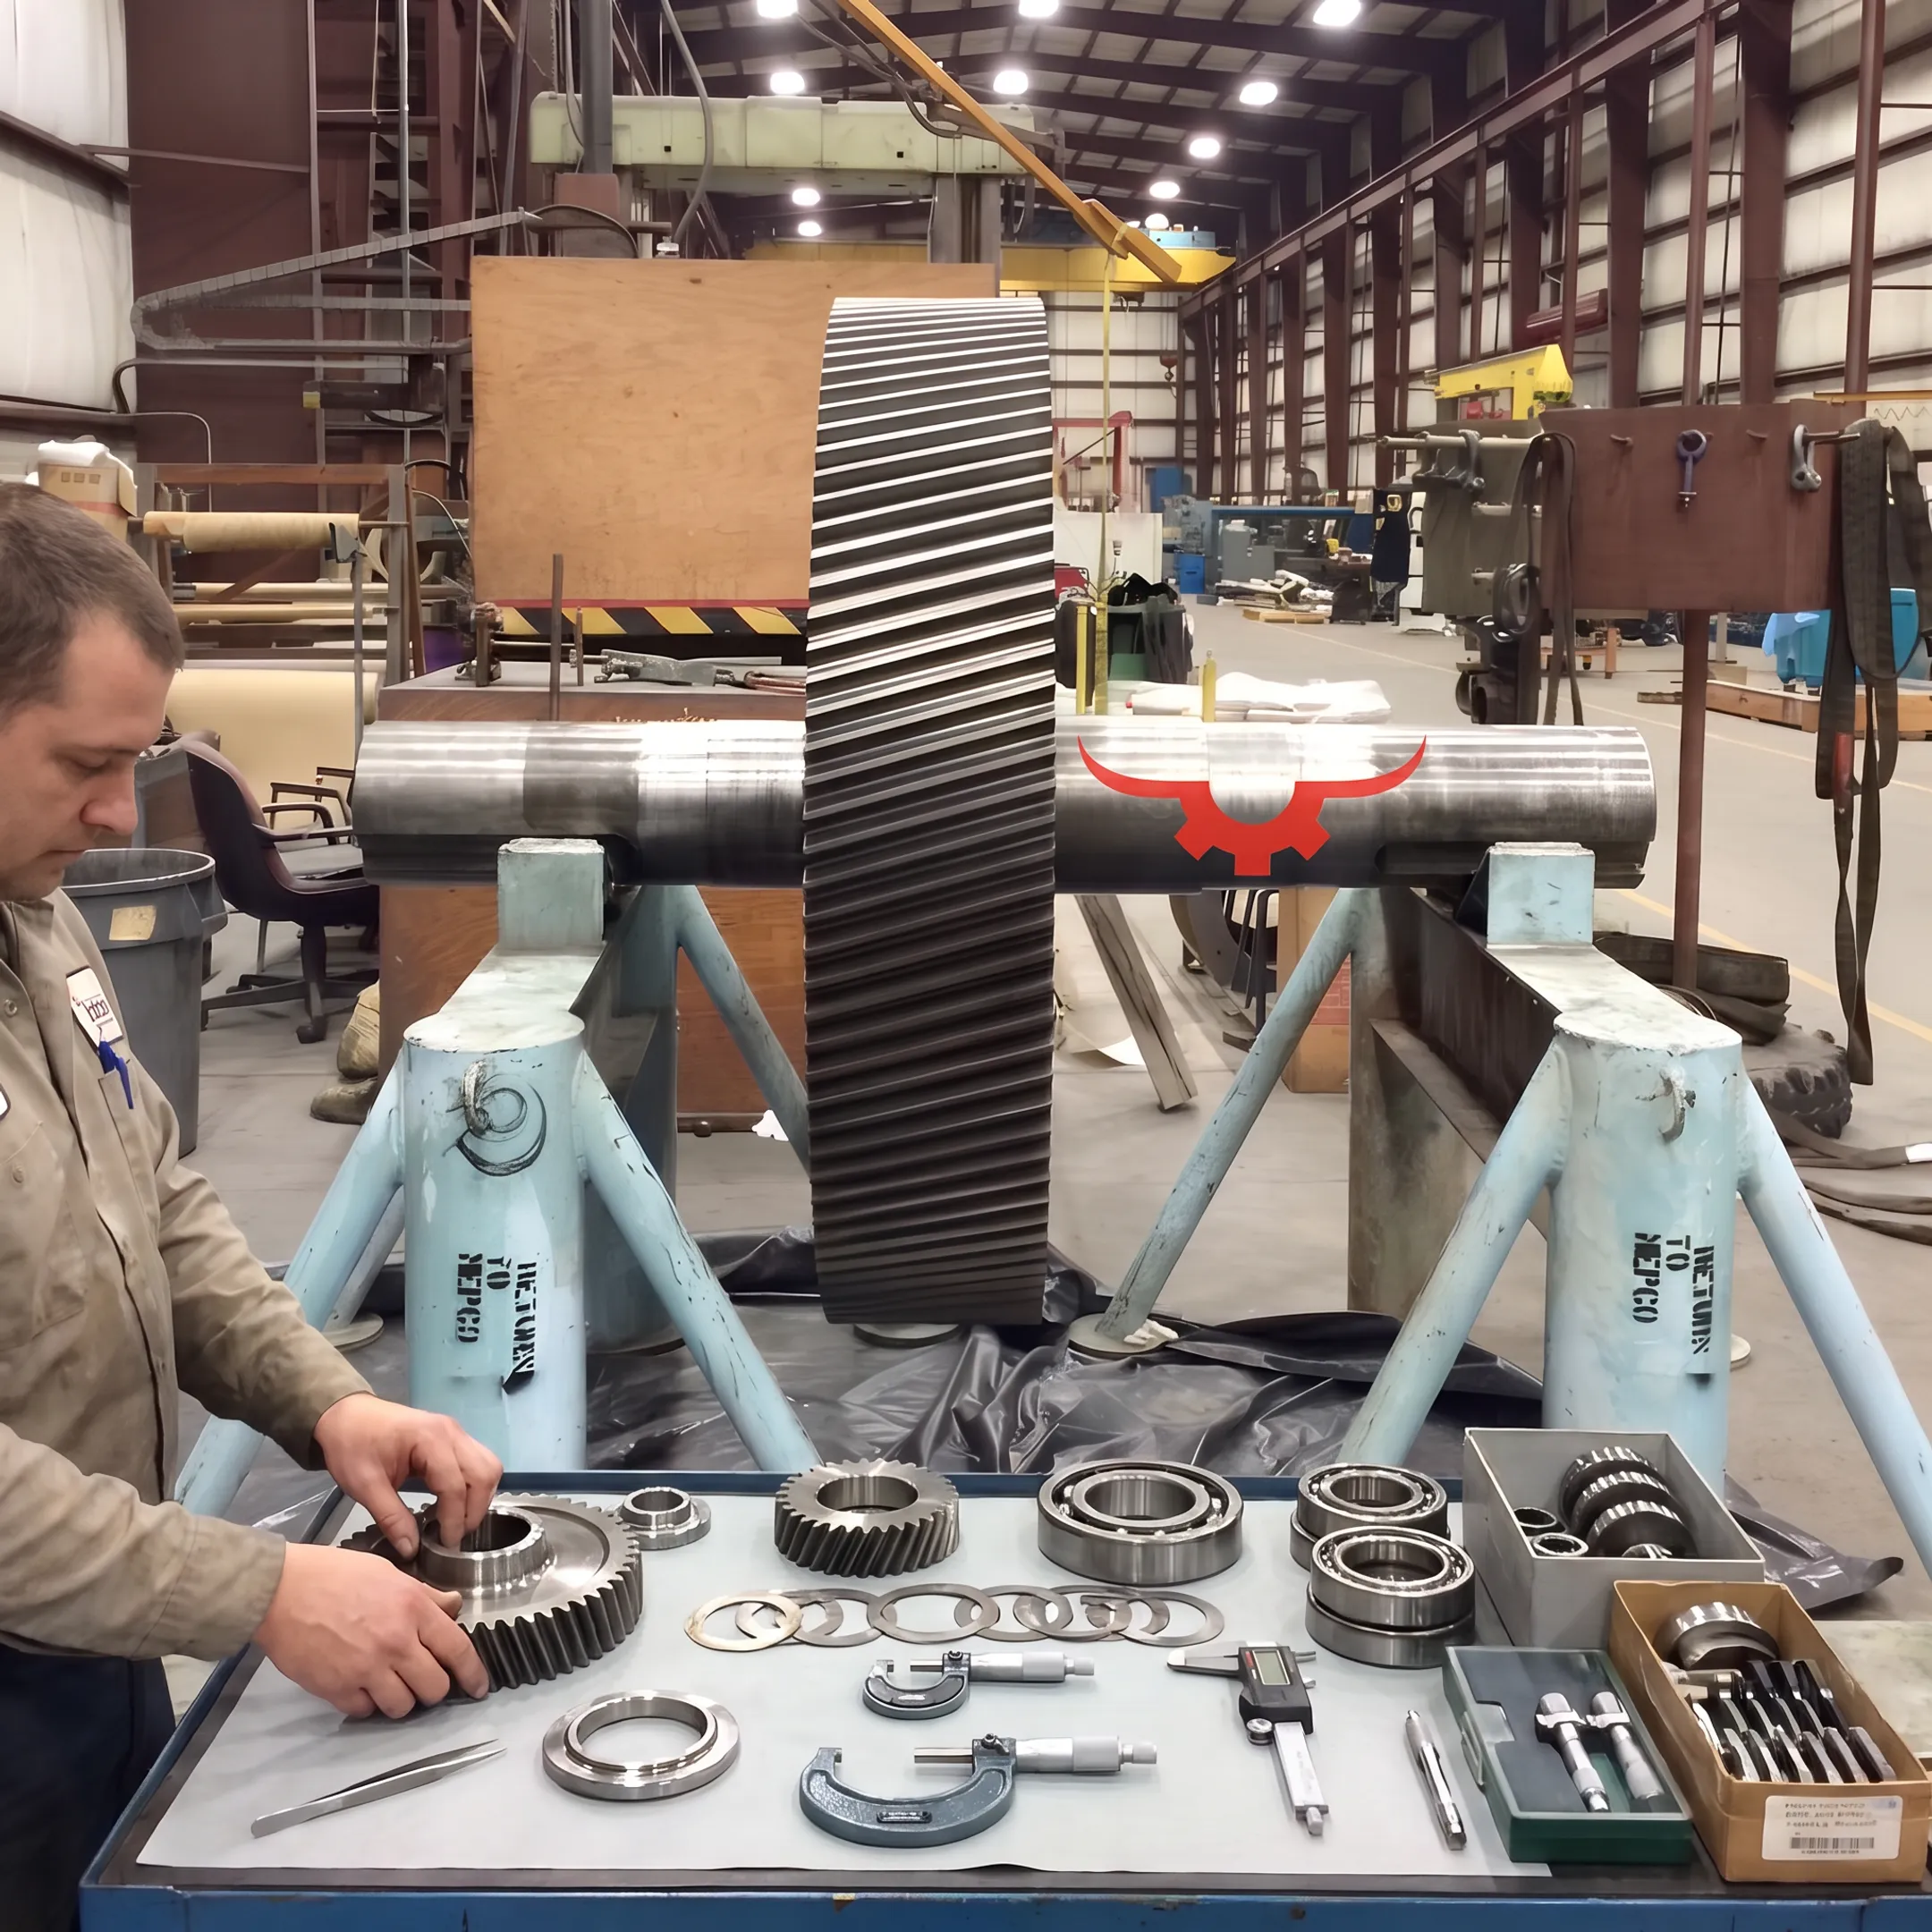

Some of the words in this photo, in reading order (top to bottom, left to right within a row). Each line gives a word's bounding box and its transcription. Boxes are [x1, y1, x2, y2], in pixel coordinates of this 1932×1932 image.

[487, 1256, 513, 1290] TO
[1632, 1233, 1662, 1324] NEPCO
[1665, 1235, 1691, 1272] TO
[456, 1252, 483, 1343] NEPCO
